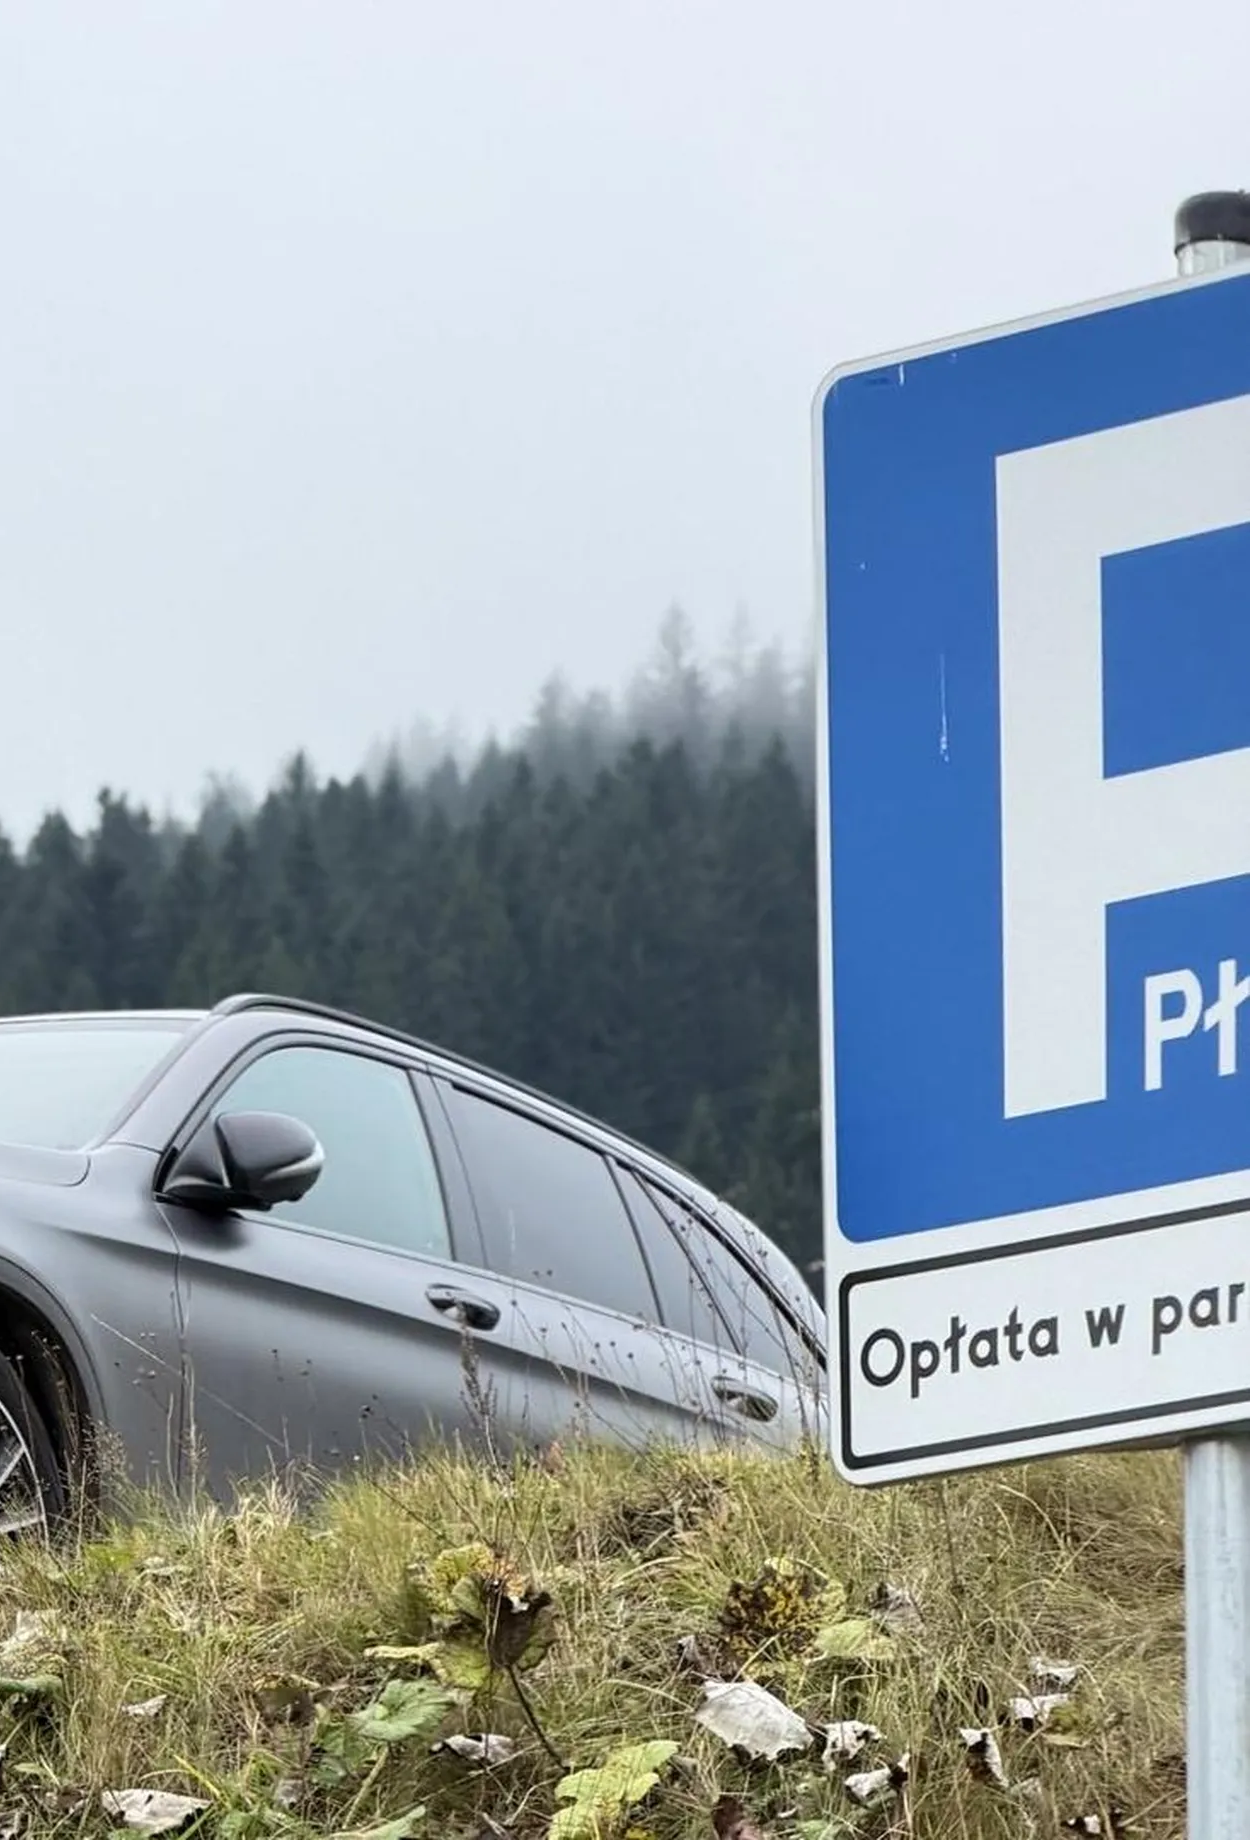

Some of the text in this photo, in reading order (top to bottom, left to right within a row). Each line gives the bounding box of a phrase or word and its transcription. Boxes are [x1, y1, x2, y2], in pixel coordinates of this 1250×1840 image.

[1144, 957, 1250, 1091] Pł
[860, 1282, 1245, 1399] Opłata w par
